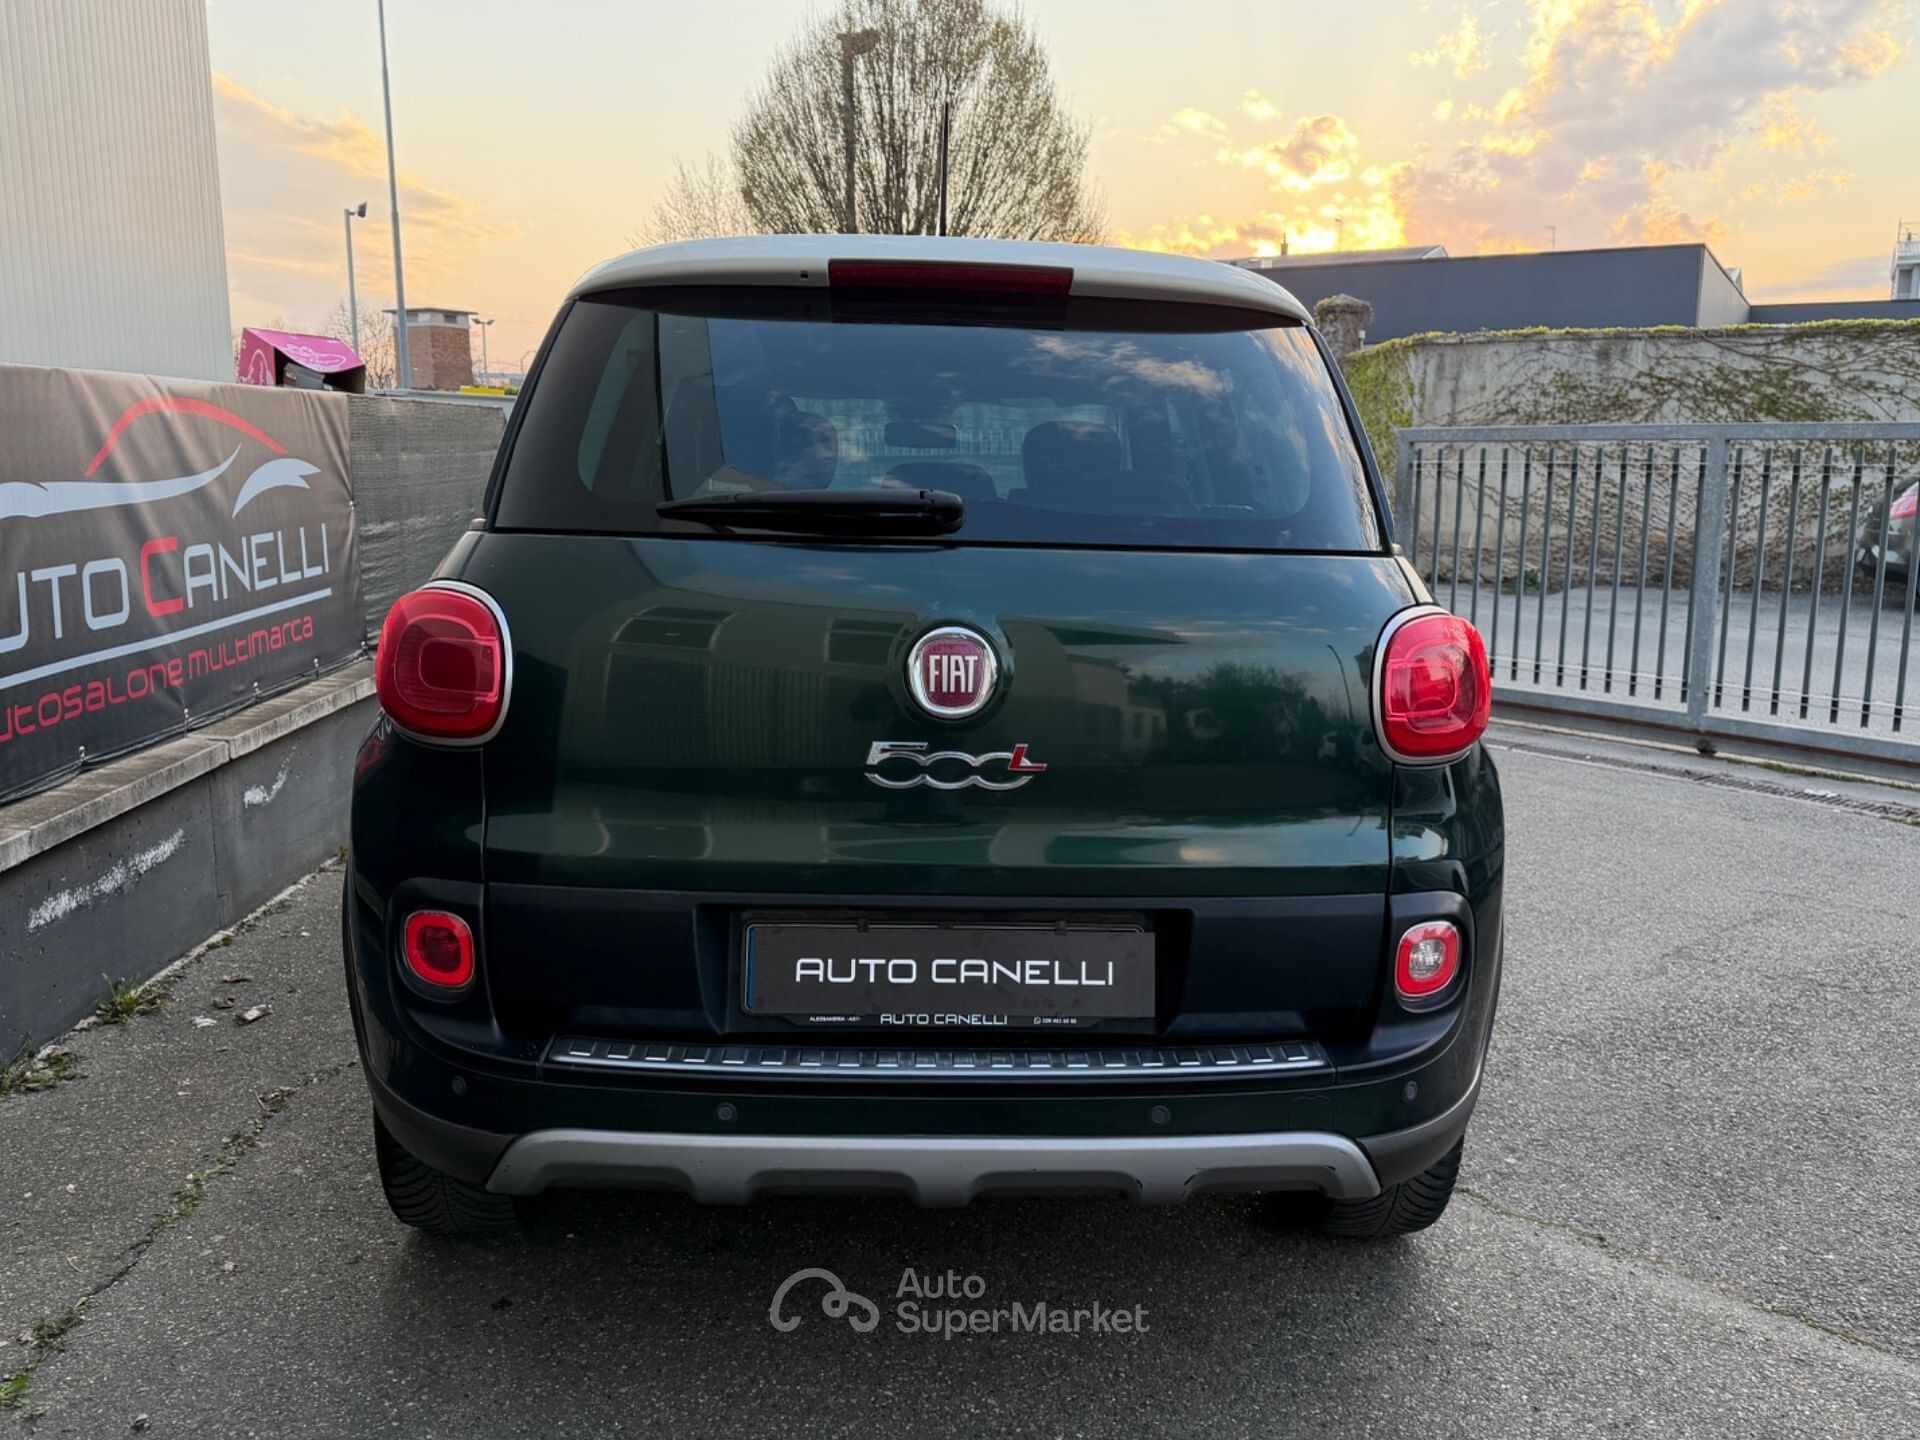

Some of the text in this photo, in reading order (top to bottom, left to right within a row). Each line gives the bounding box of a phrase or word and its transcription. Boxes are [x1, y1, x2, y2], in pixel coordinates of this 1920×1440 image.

[0, 523, 332, 653] UTO CANELLI
[188, 615, 315, 679] multimarca
[929, 654, 978, 693] FIAT
[795, 958, 1114, 986] AUTO CANELLI
[880, 1013, 1008, 1025] AUTO CANELLI
